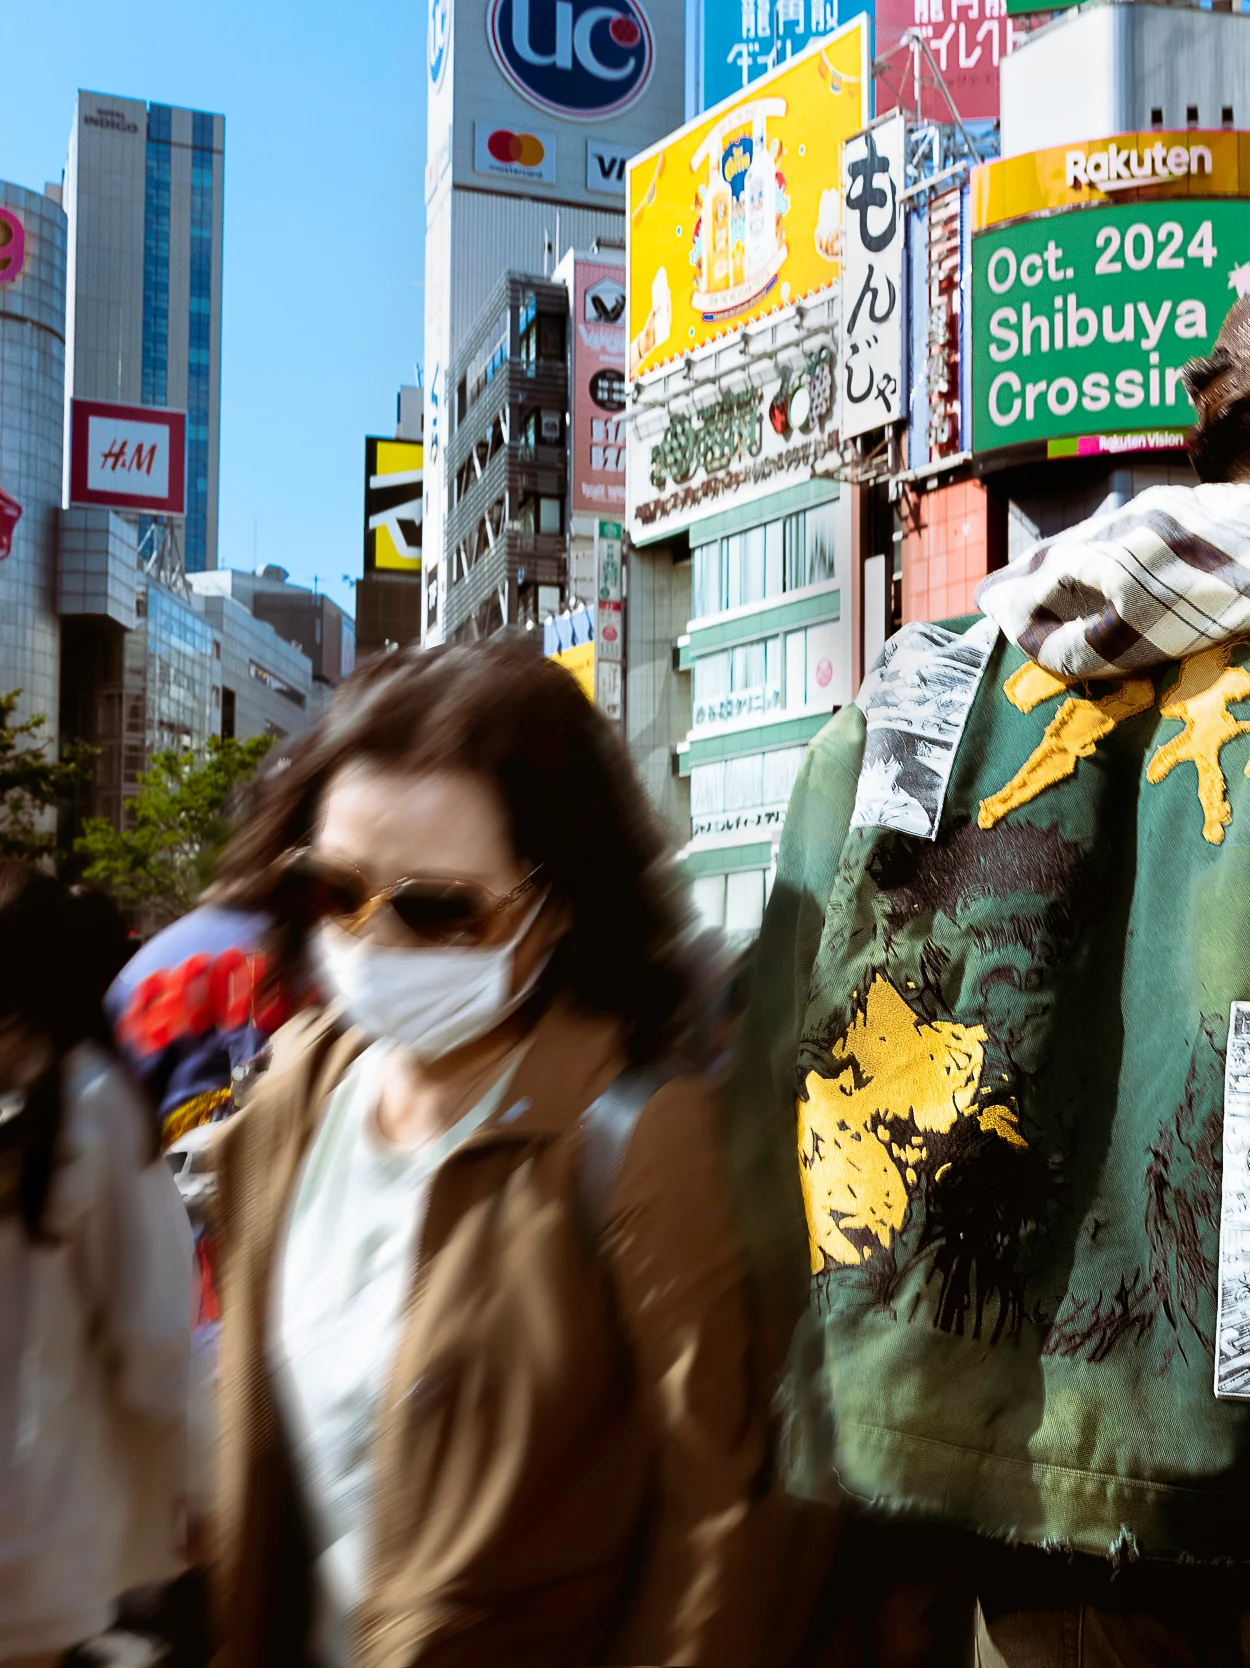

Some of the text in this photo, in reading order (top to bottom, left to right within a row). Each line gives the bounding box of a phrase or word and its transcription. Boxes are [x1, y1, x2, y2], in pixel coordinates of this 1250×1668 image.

[597, 155, 626, 181] VI
[1065, 141, 1213, 188] Rakuten
[846, 135, 898, 413] もんじゃ
[987, 219, 1218, 295] Oct. 2024
[988, 292, 1208, 362] Shibuya
[988, 351, 1194, 427] Crossin
[101, 438, 158, 477] H&M
[1147, 431, 1184, 448] Vision
